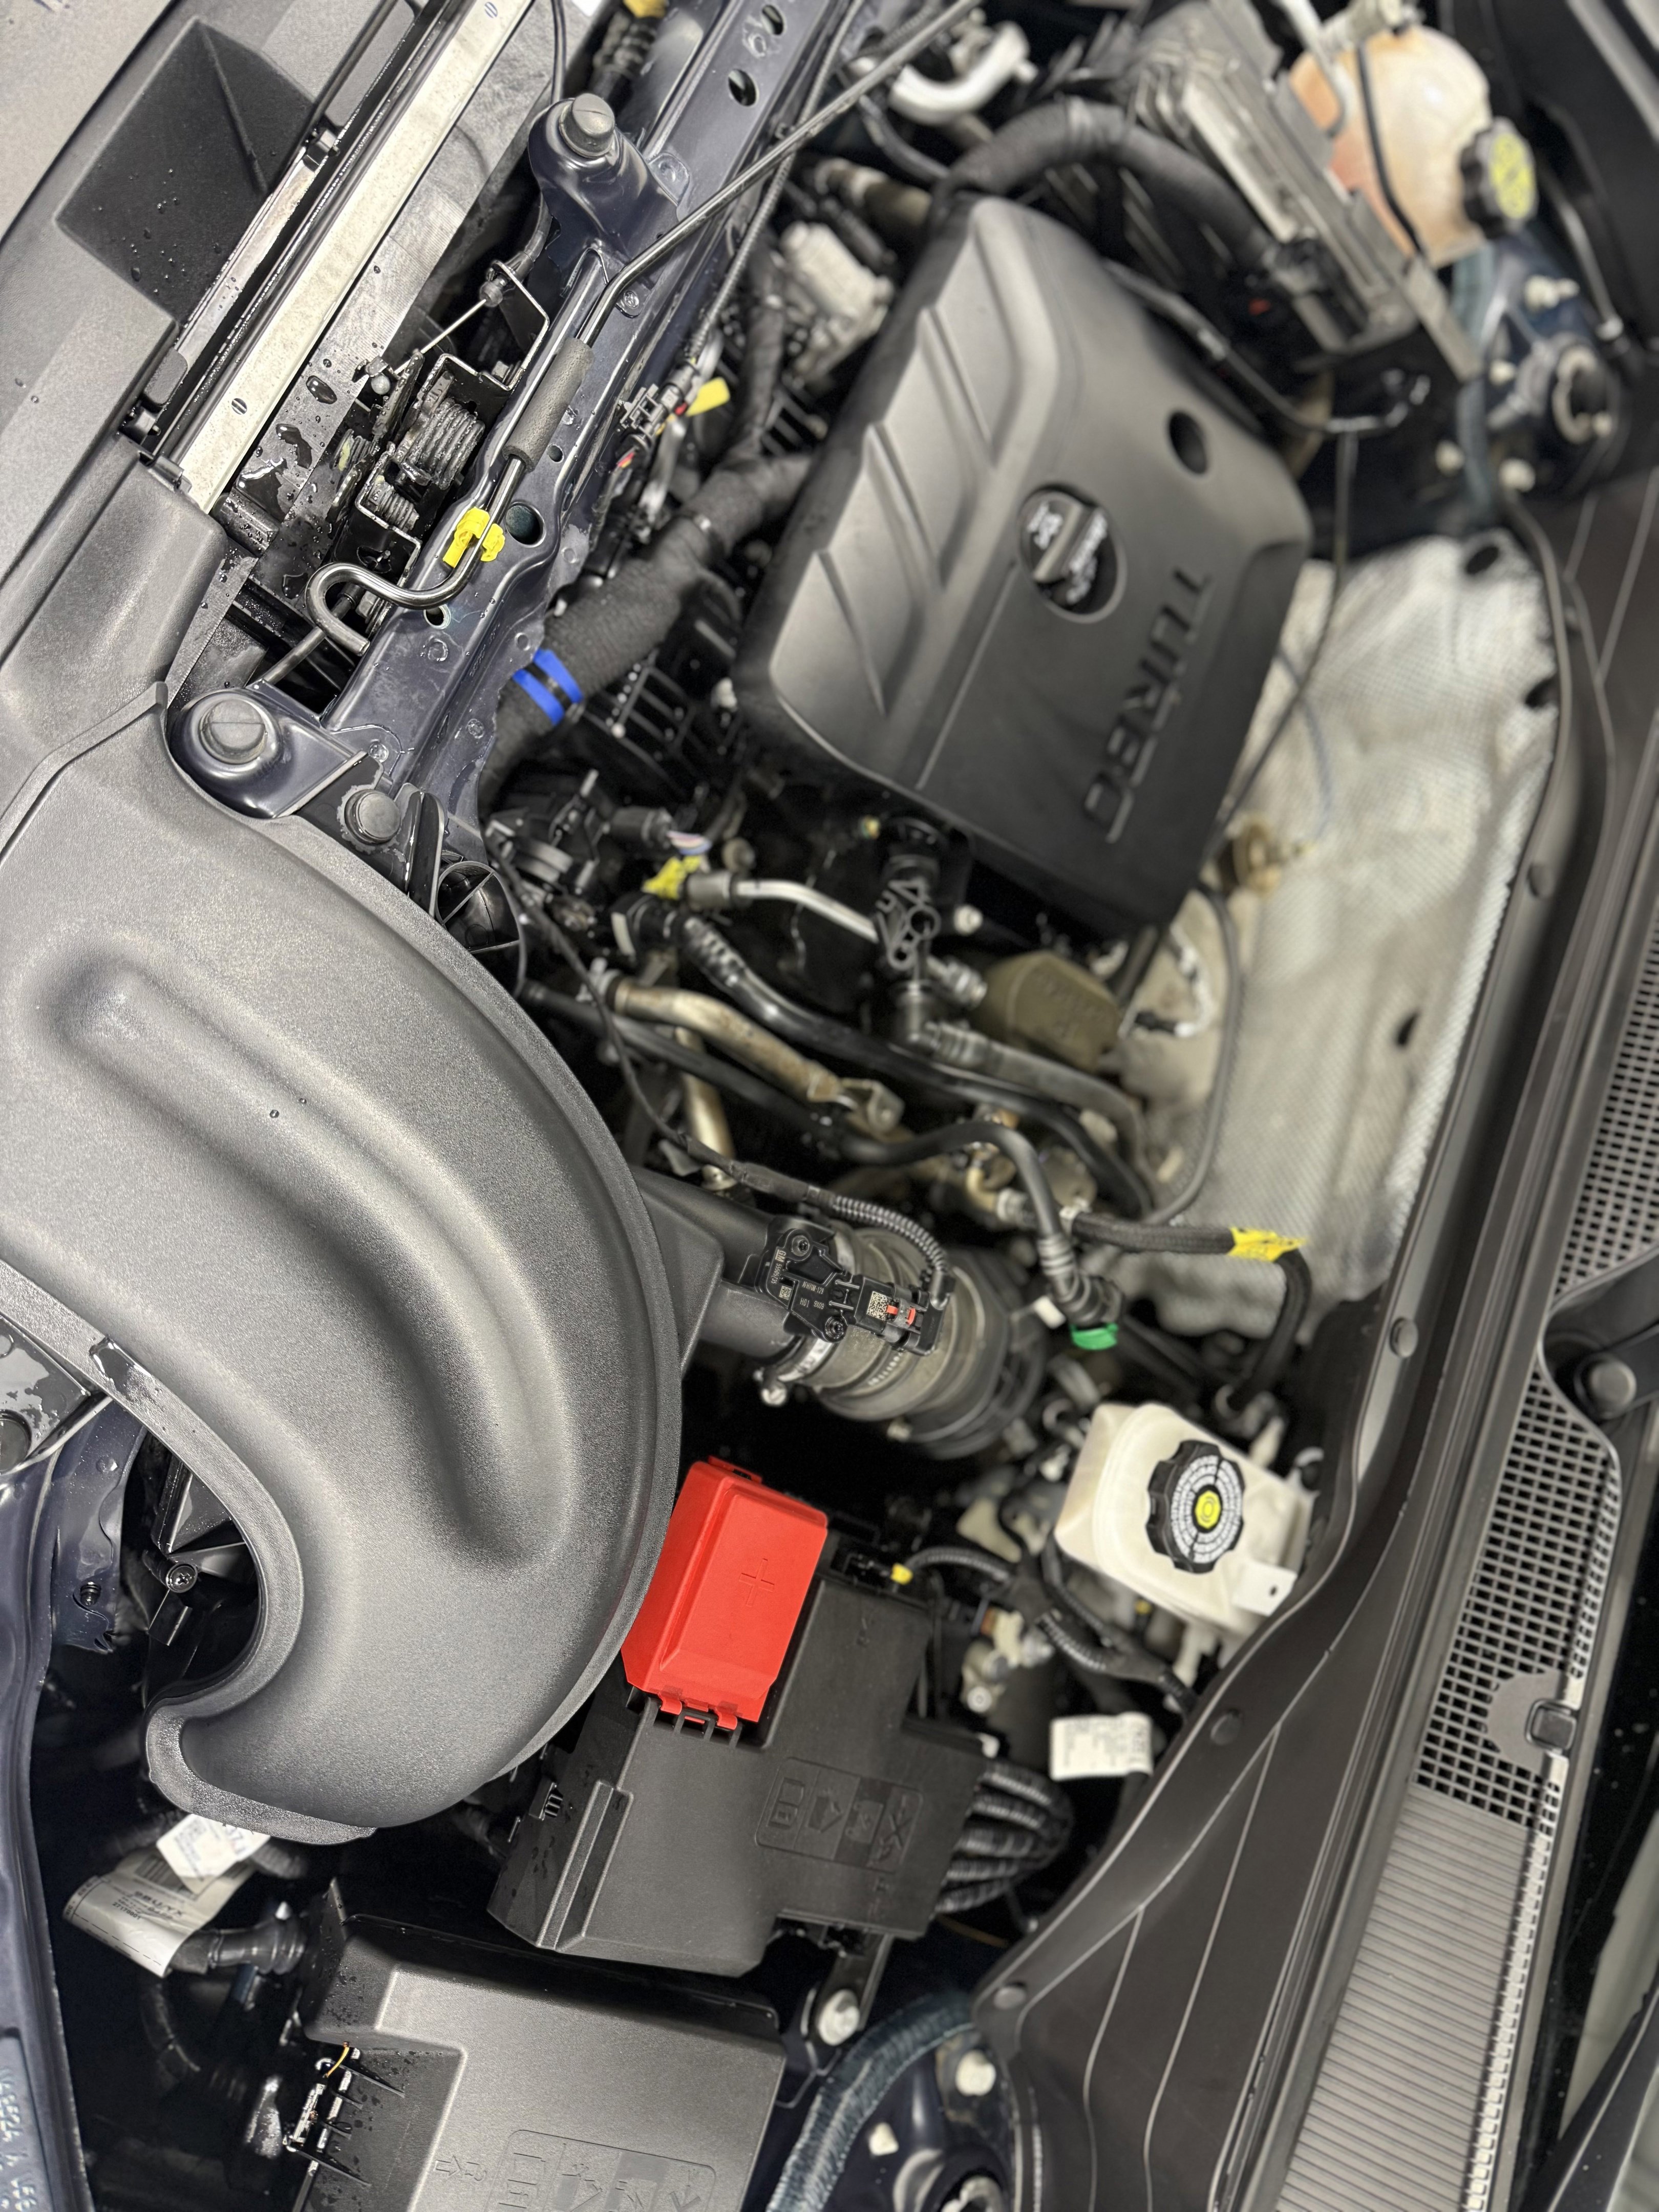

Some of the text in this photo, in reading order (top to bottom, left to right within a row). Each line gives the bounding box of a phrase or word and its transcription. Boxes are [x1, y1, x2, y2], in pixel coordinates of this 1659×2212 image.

[1082, 567, 1213, 844] TURBO
[771, 1249, 786, 1284] GM 55505735
[112, 1902, 142, 1920] 27170001
